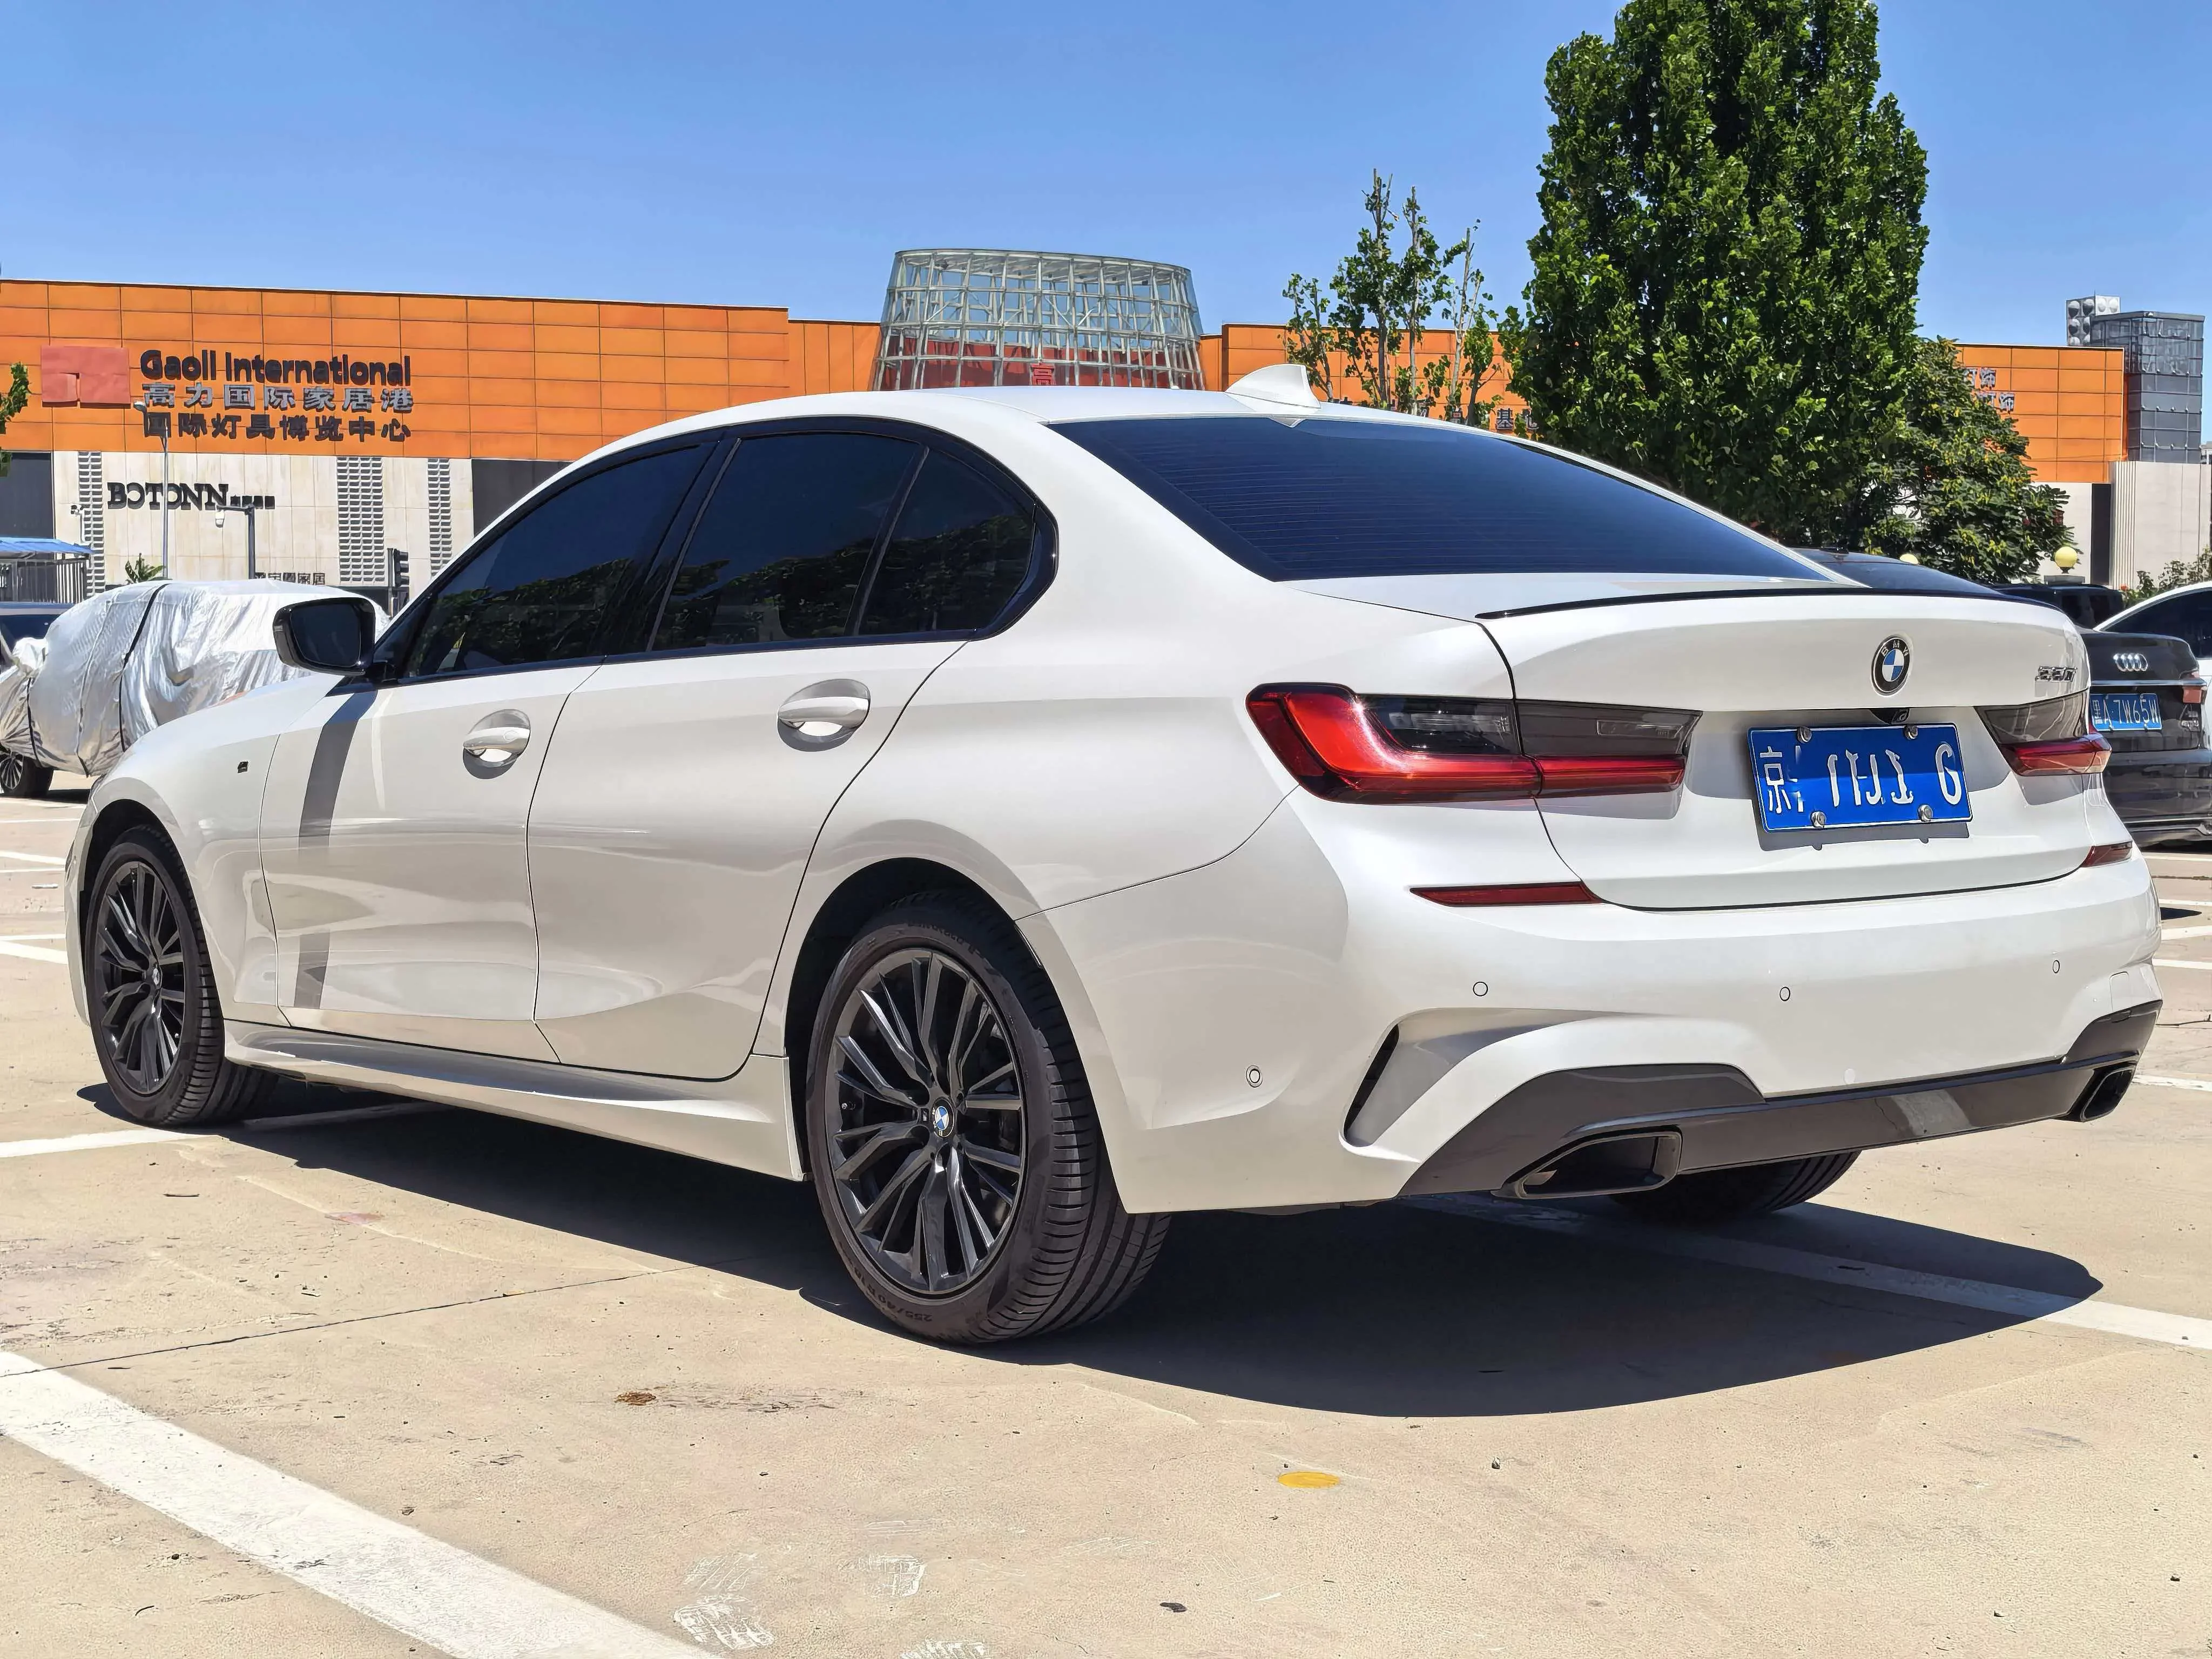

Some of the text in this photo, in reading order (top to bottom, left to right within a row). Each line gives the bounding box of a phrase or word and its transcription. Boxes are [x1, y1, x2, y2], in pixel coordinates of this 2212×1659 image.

[225, 352, 411, 386] International
[141, 382, 414, 414] 高力国际家居港
[144, 412, 411, 442] 国际灯具博览中心
